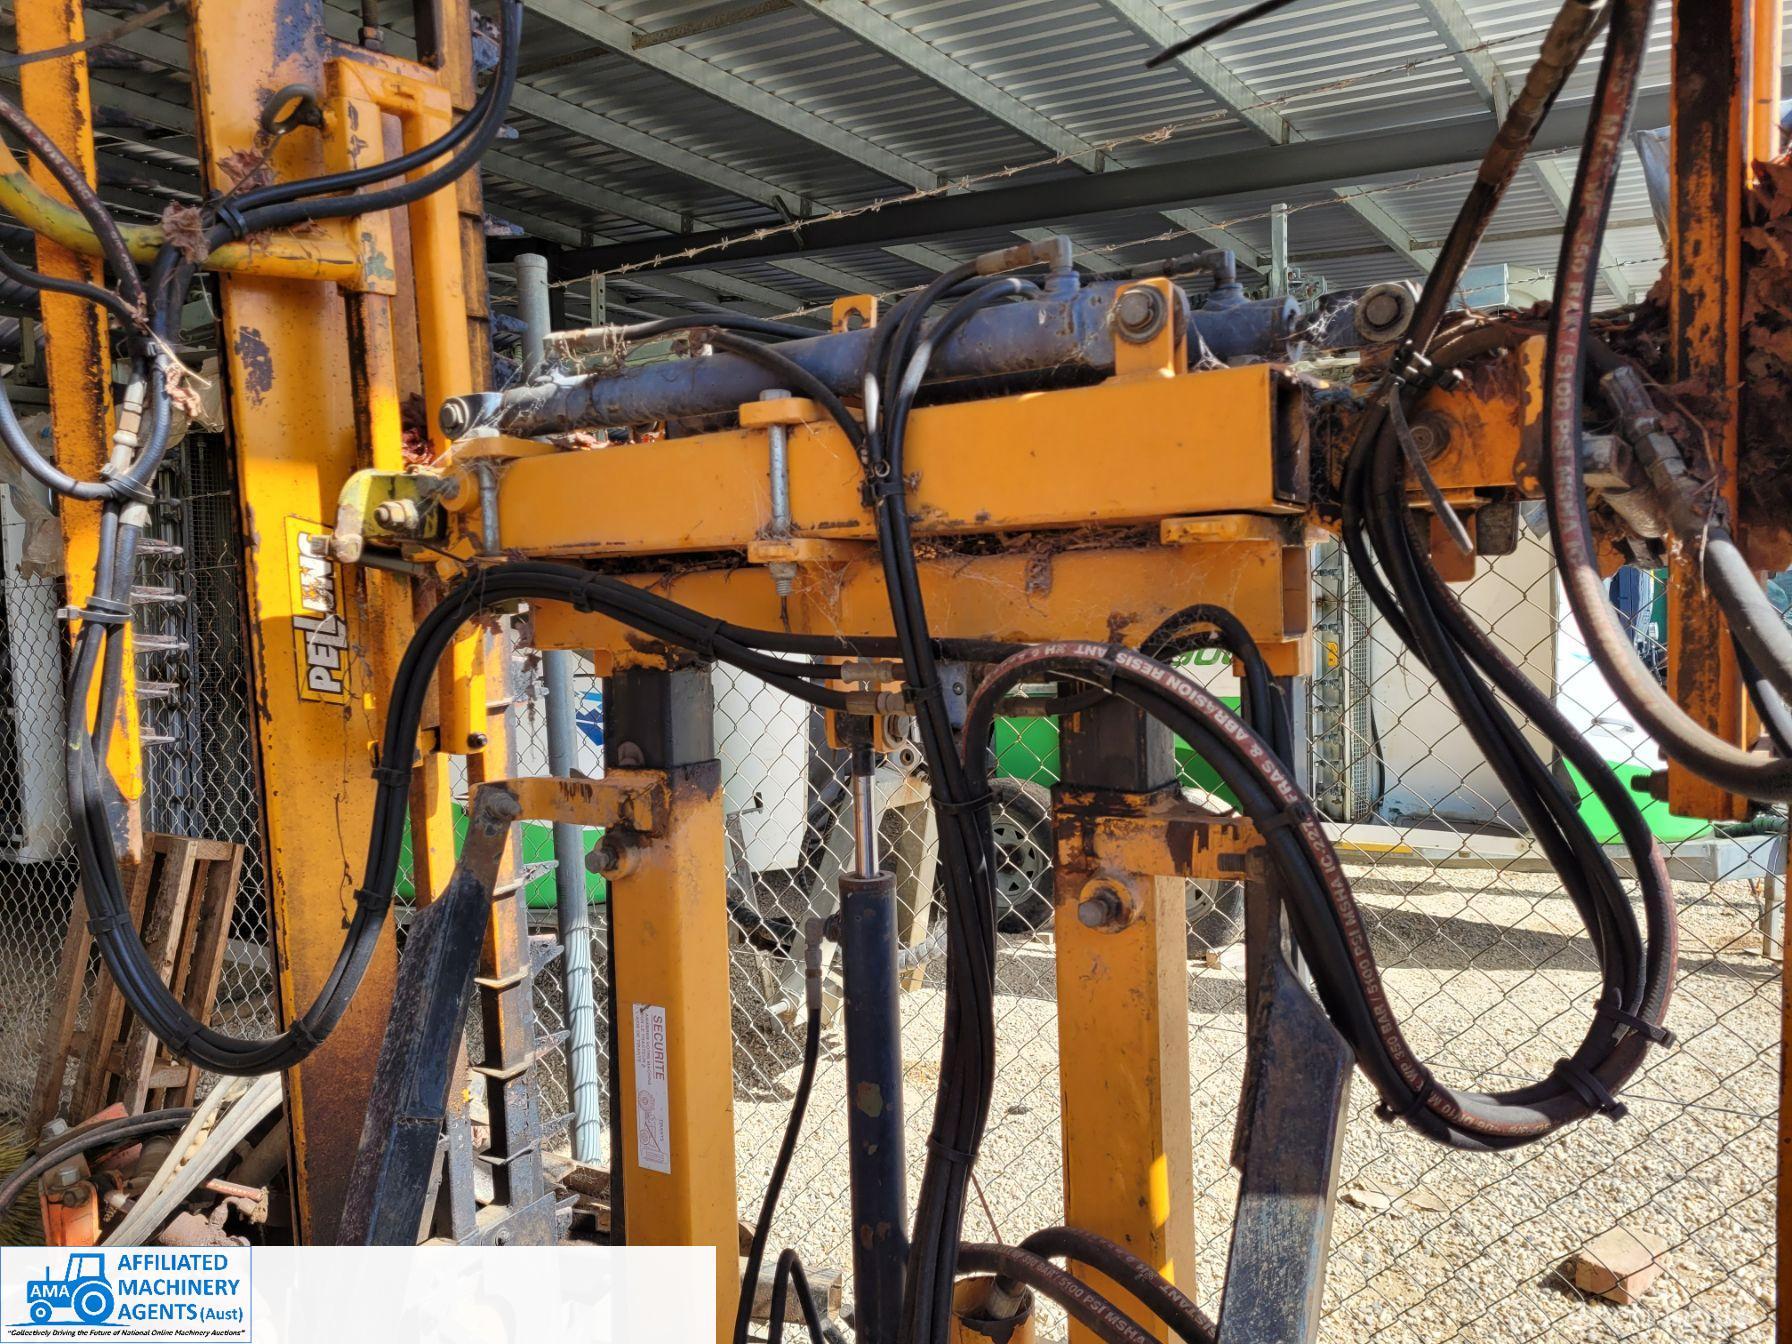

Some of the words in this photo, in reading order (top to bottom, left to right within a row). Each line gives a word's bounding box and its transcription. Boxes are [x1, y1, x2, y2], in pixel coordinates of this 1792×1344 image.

[35, 134, 64, 165] MAX
[1555, 353, 1574, 412] 5100
[1074, 641, 1171, 682] RESISANT
[1166, 675, 1247, 742] ABRASION
[1250, 745, 1265, 759] &
[1260, 761, 1299, 801] FRAS
[1329, 878, 1357, 927] MSHA
[1347, 928, 1365, 957] PSI
[1358, 958, 1379, 994] 5100
[1373, 1005, 1393, 1035] BAR
[653, 1014, 665, 1081] SECURITE
[1386, 1037, 1405, 1061] 350
[1058, 1277, 1084, 1298] 5100
[1083, 1294, 1108, 1314] PSI
[1105, 1311, 1146, 1344] MSHA
[1159, 1284, 1217, 1341] SISTANT
